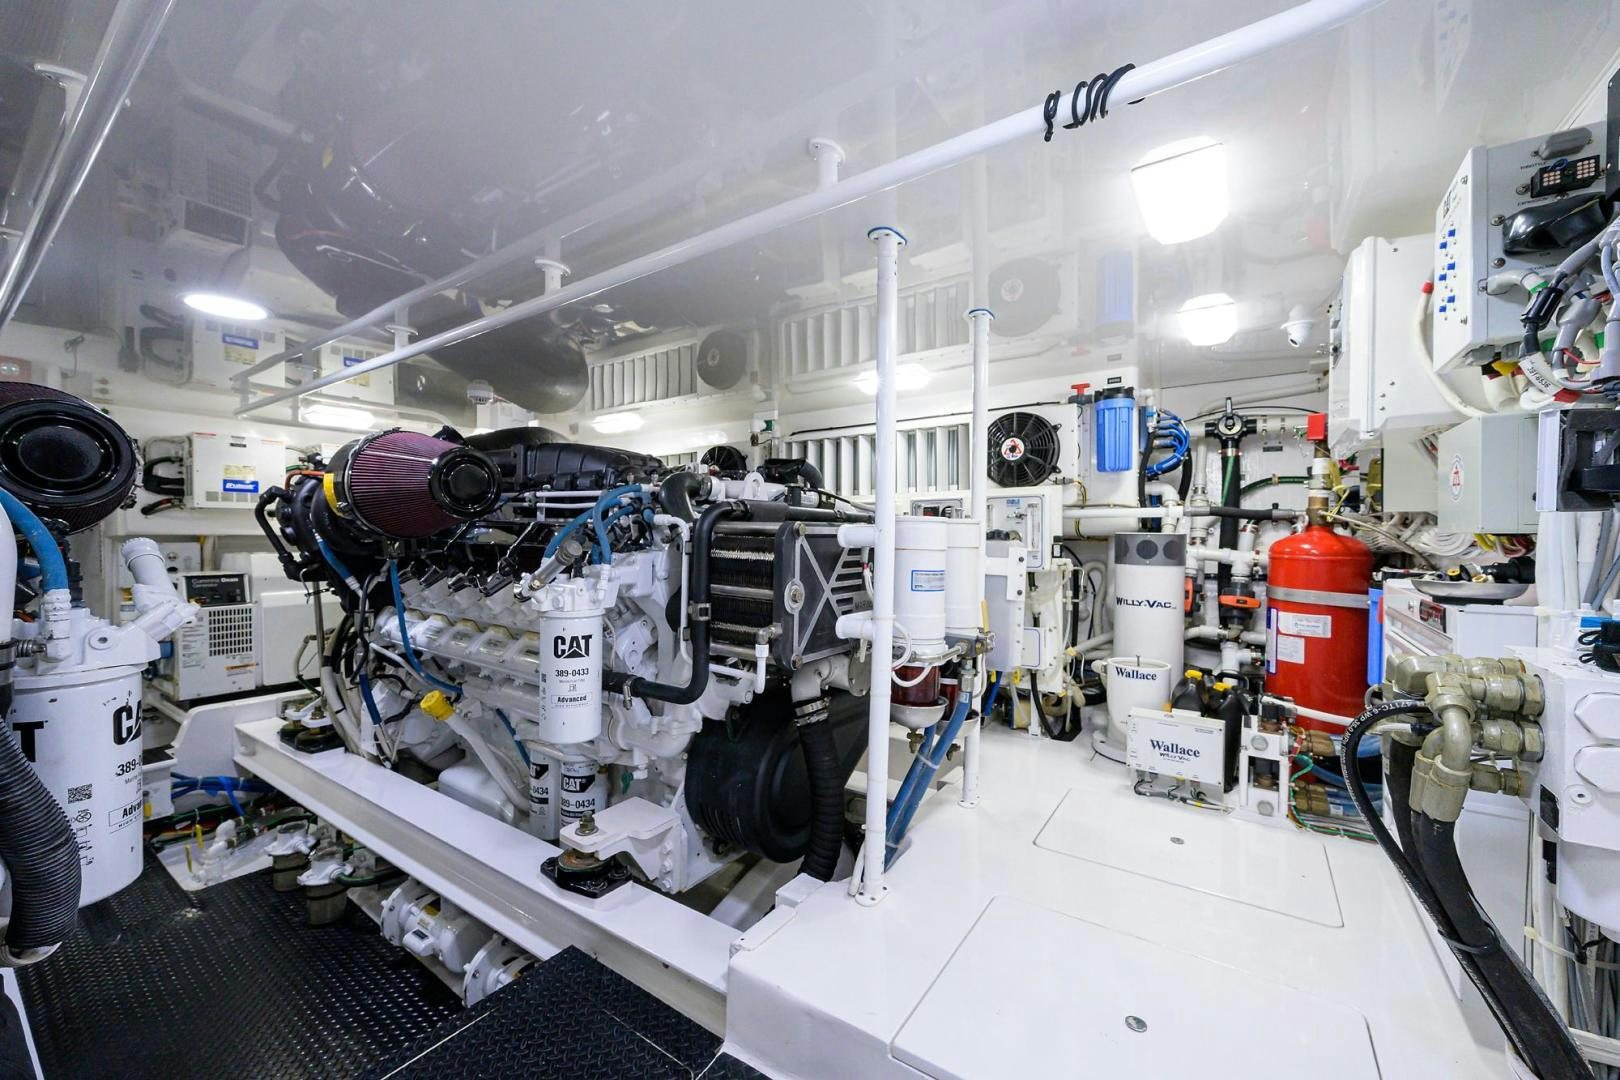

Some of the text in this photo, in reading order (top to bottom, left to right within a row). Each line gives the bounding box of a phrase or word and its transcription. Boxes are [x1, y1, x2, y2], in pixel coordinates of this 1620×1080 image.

[553, 634, 593, 659] CAT
[555, 667, 590, 677] 389-0433
[1115, 666, 1157, 681] Wallace
[557, 694, 587, 703] Advanced
[1150, 738, 1201, 758] Wallace
[563, 777, 582, 792] CAT
